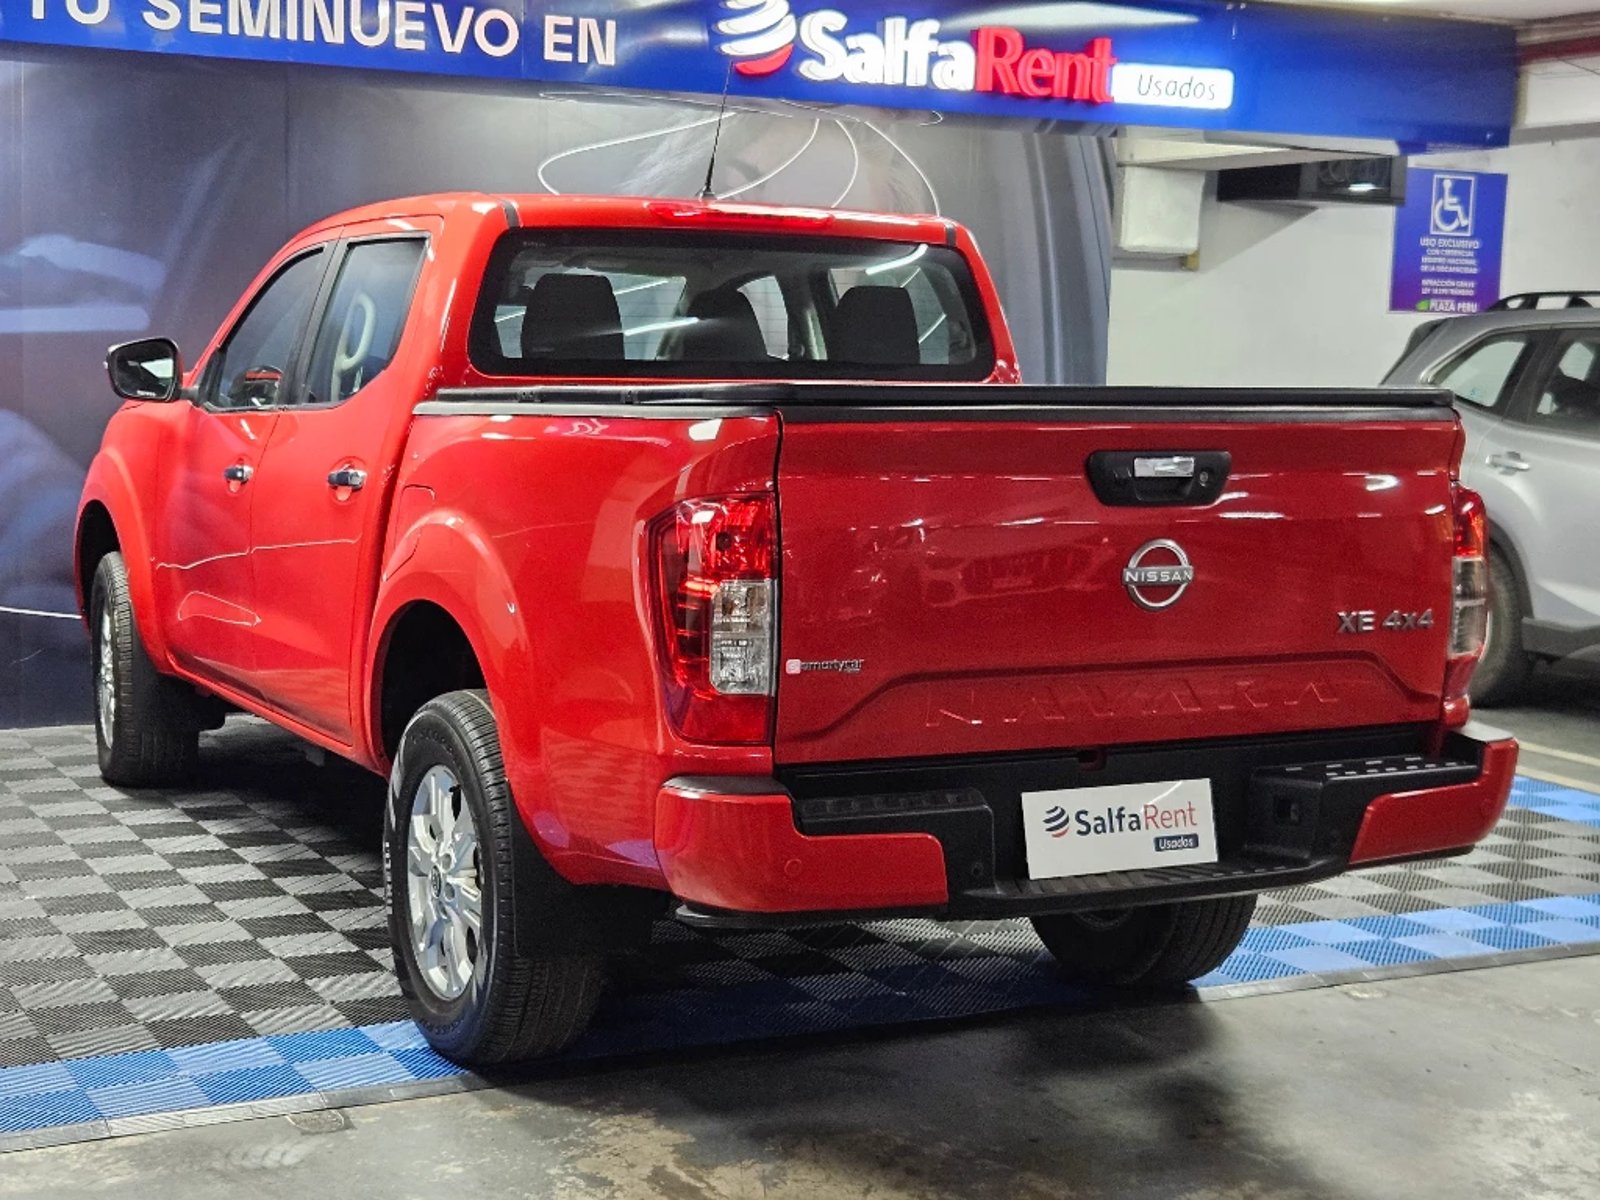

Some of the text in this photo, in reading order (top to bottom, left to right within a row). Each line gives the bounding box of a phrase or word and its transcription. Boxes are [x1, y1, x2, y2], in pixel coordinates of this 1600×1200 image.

[142, 0, 519, 57] SEMINUEVO
[541, 15, 618, 66] EN
[796, 9, 1117, 105] SalfaRent
[1137, 73, 1216, 101] Usados
[1124, 568, 1194, 583] NISSAN
[1337, 608, 1435, 634] XE 4x4
[1074, 801, 1198, 837] SalfaRent
[1158, 836, 1194, 850] Usados
